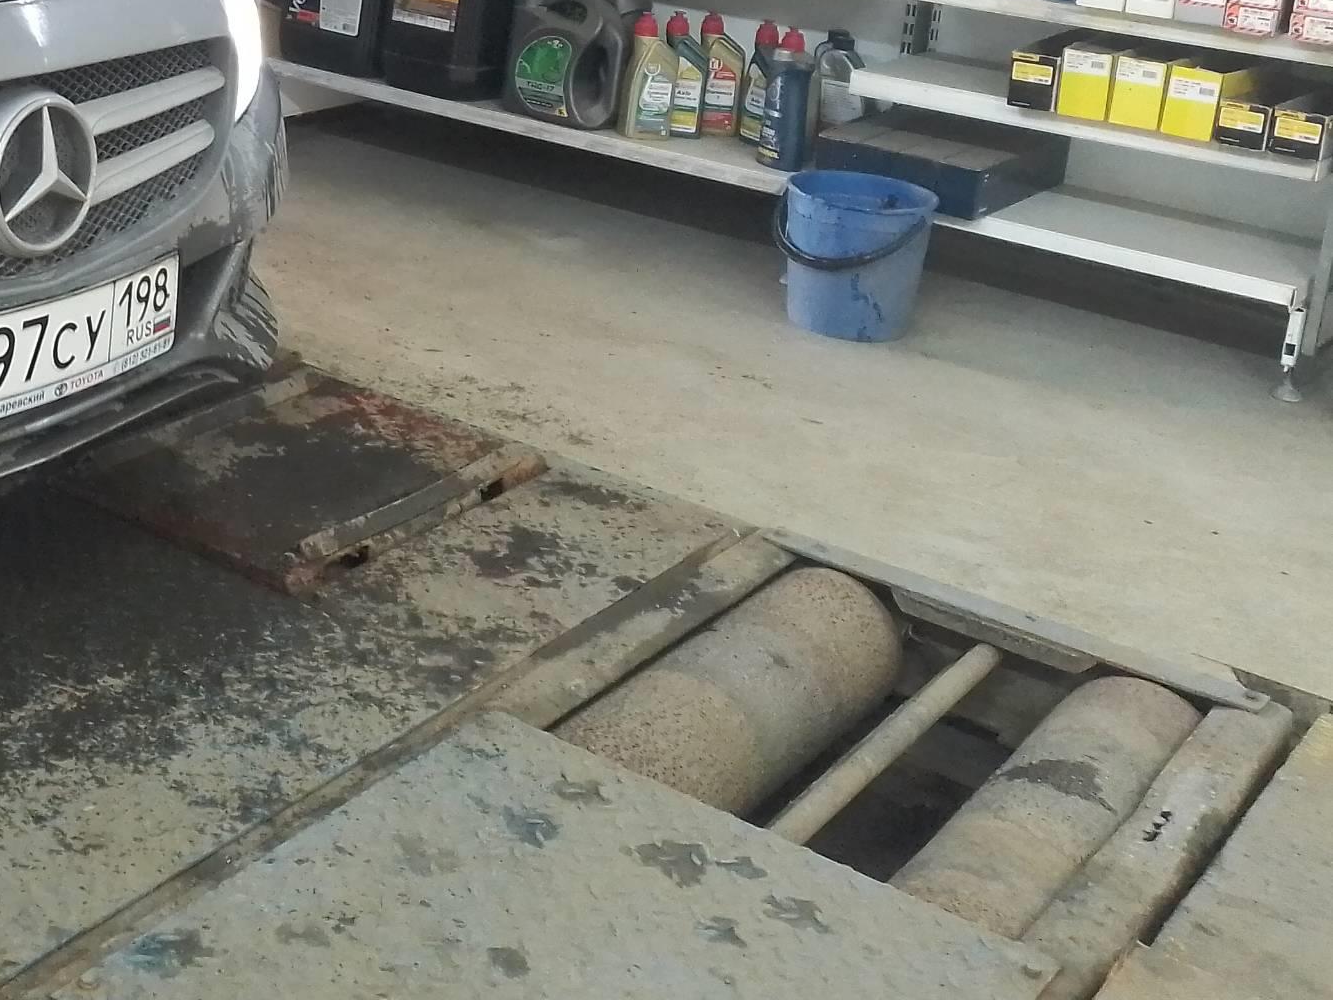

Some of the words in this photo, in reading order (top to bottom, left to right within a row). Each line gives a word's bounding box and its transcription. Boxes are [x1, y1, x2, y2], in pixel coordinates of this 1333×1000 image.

[118, 267, 171, 328] 198
[126, 321, 154, 347] RUS
[70, 369, 105, 391] TOYOTA
